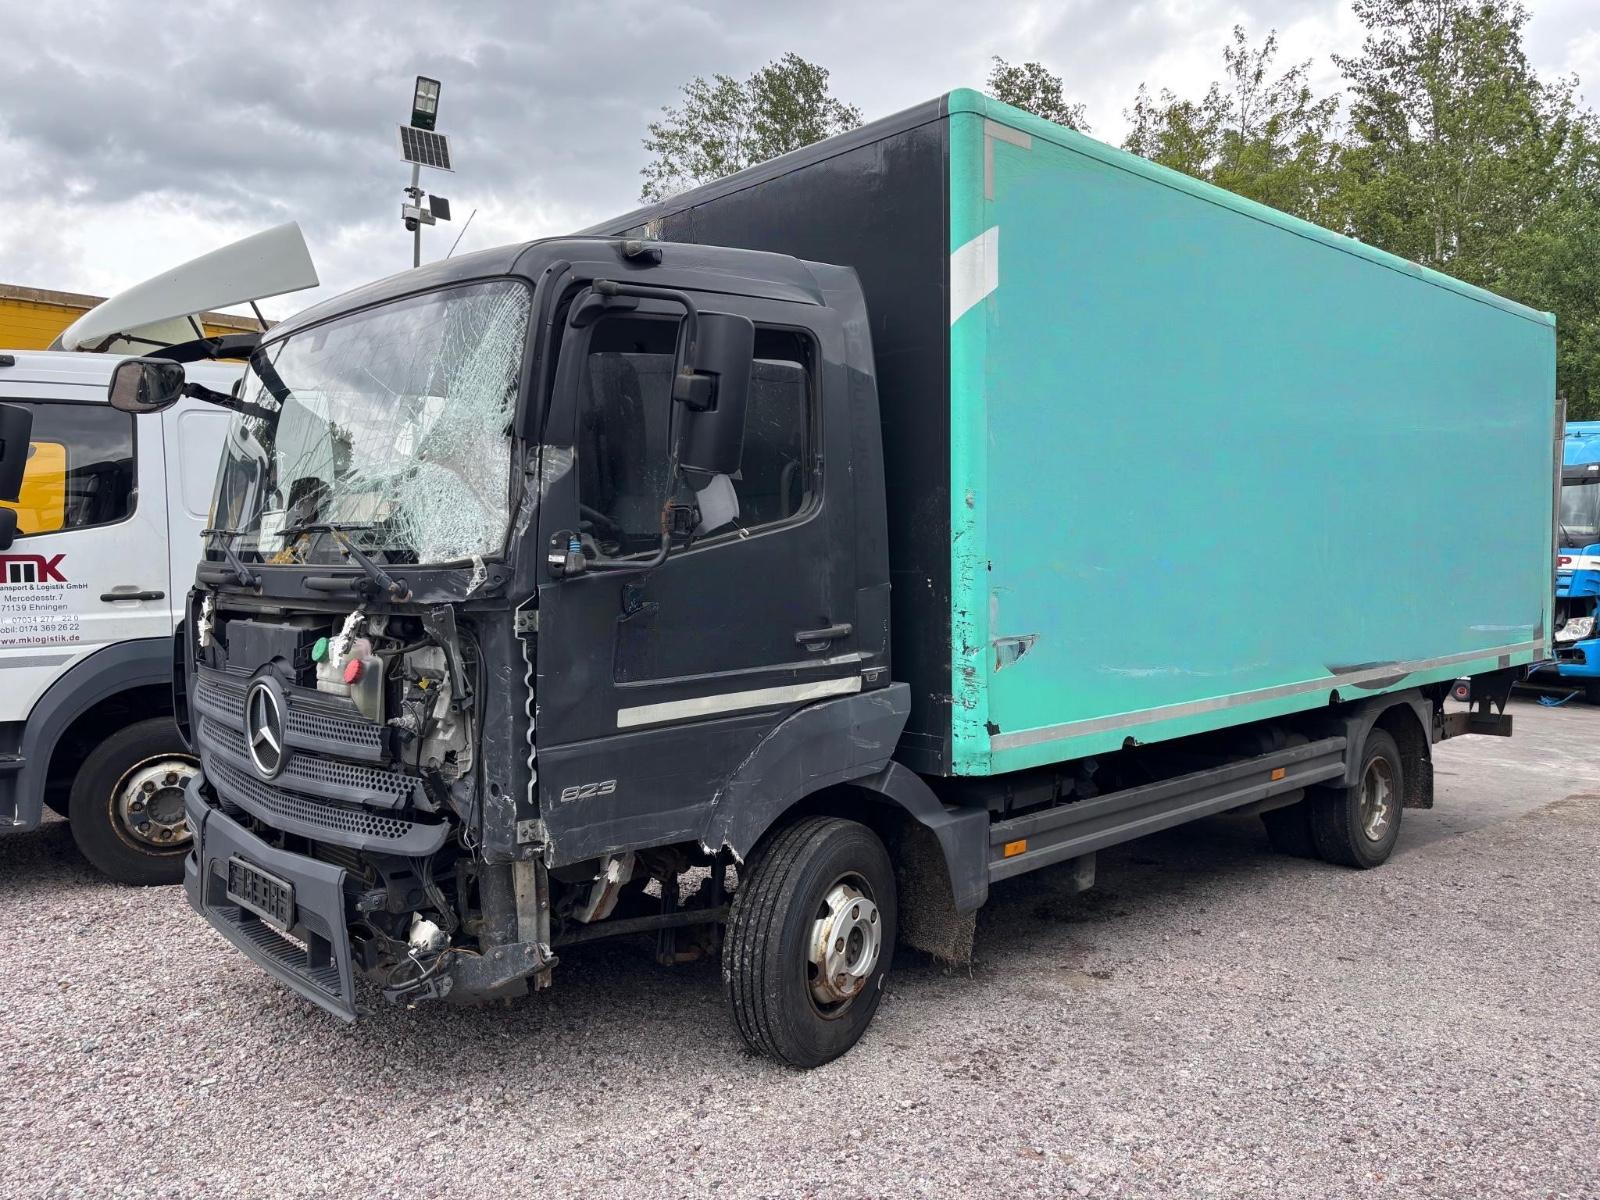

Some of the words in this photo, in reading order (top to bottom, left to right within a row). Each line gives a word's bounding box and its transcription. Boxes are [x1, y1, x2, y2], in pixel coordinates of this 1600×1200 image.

[0, 584, 28, 592] ansport
[37, 583, 65, 591] Logistik
[4, 594, 58, 602] Mercedesstr.
[1, 604, 27, 612] 71139
[29, 603, 68, 611] Ehningen
[0, 626, 18, 634] obil:
[19, 625, 38, 633] 0174
[40, 624, 56, 632] 369
[0, 634, 80, 645] ww.mklogistik.de
[561, 780, 617, 802] 823
